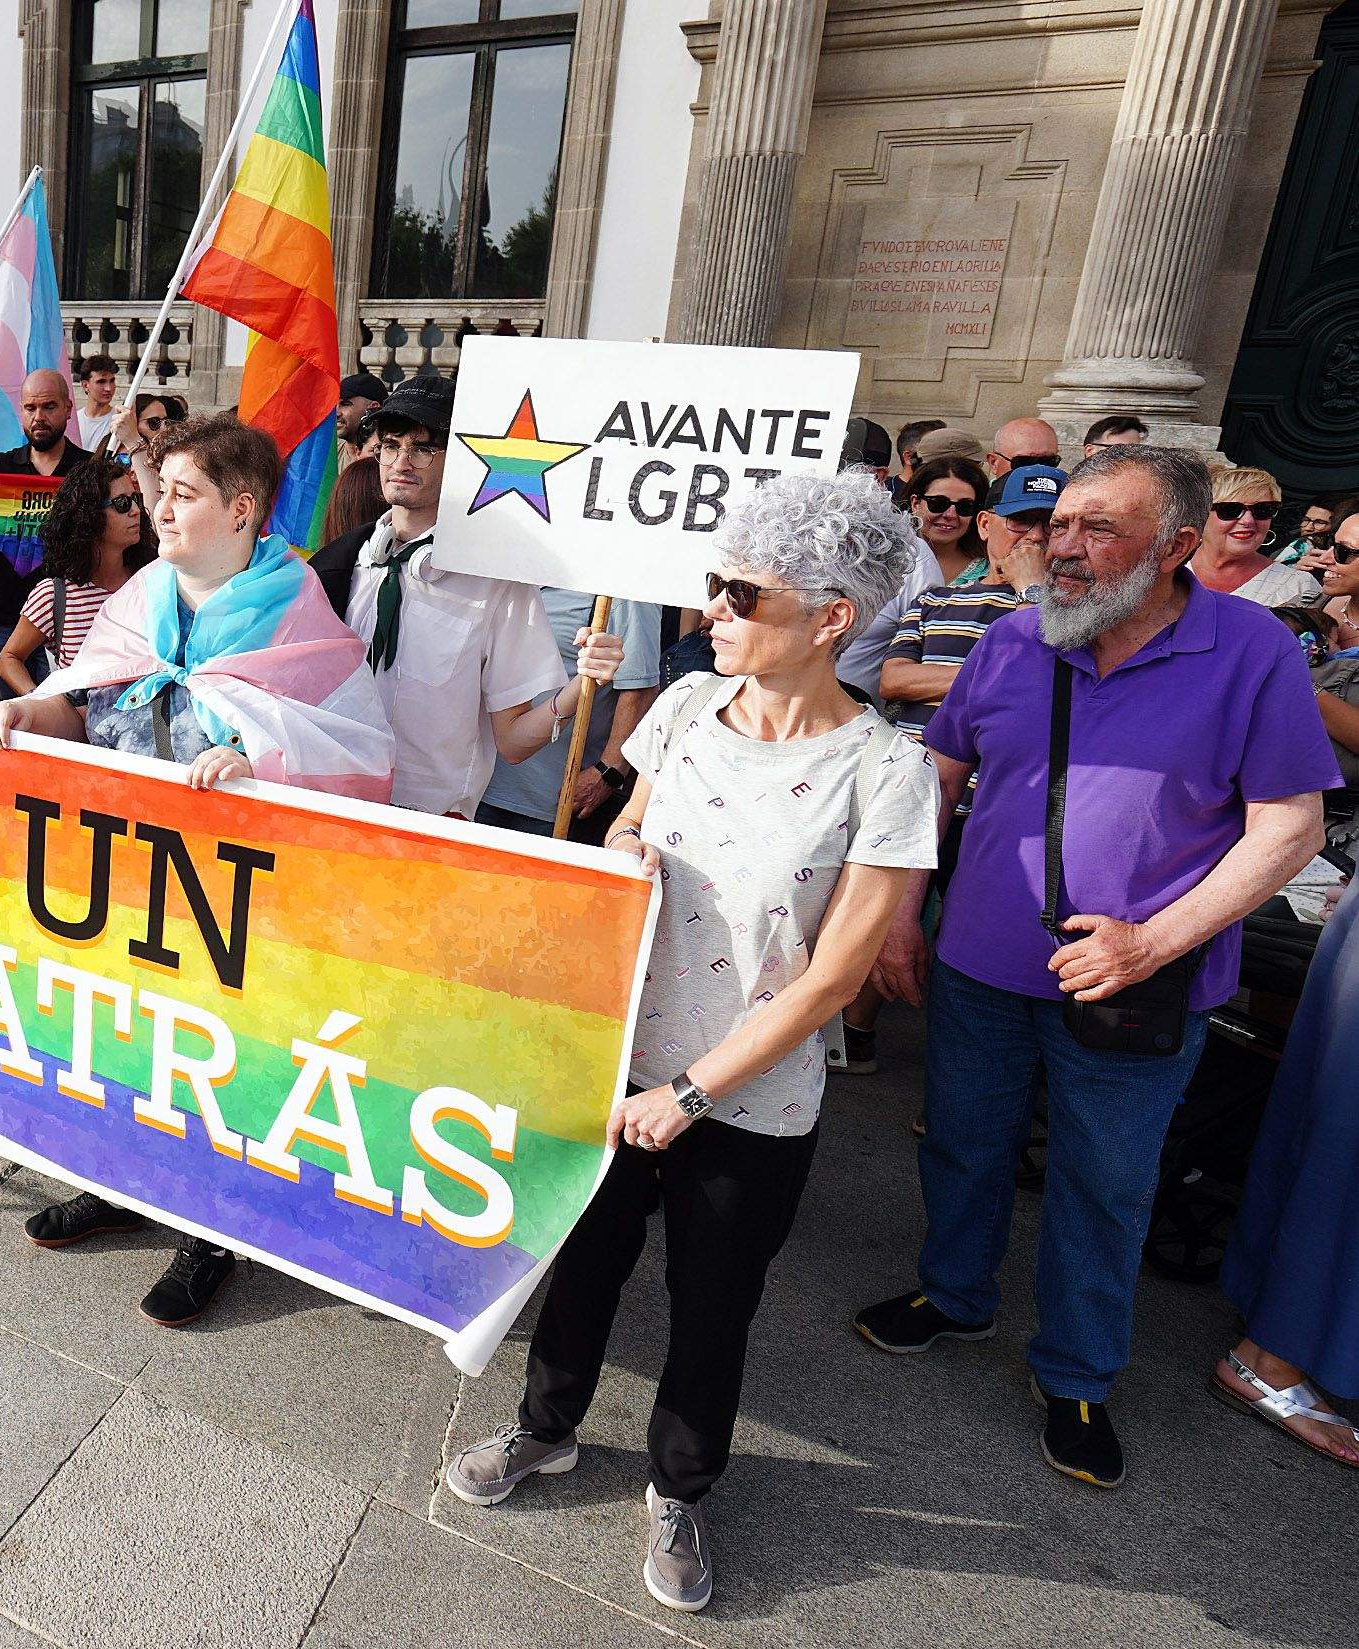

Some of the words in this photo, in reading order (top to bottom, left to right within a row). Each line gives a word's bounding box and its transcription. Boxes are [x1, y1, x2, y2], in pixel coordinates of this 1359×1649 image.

[945, 322, 987, 335] MCMXLI
[593, 400, 831, 459] AVANTE
[15, 793, 275, 995] UN
